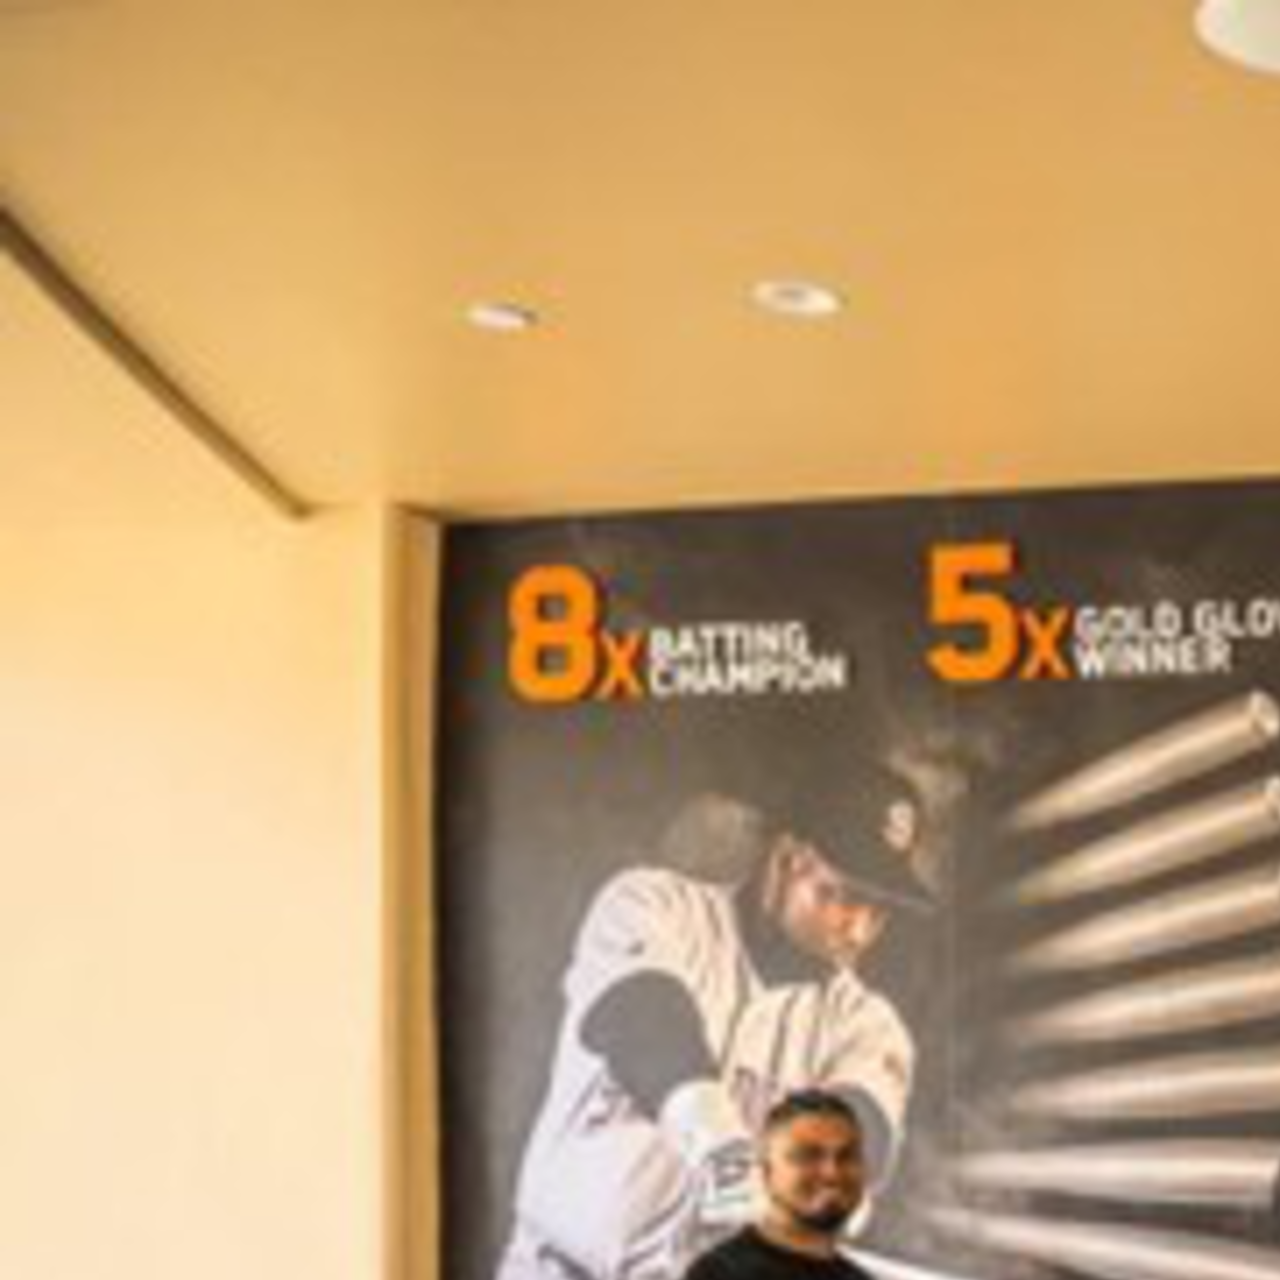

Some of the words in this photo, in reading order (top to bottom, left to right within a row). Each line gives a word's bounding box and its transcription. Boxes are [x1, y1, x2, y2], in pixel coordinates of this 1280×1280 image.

[649, 620, 807, 658] BATTING
[1075, 602, 1182, 644] GOLD
[650, 653, 846, 697] CHAMPION
[1074, 634, 1232, 680] WINNER
